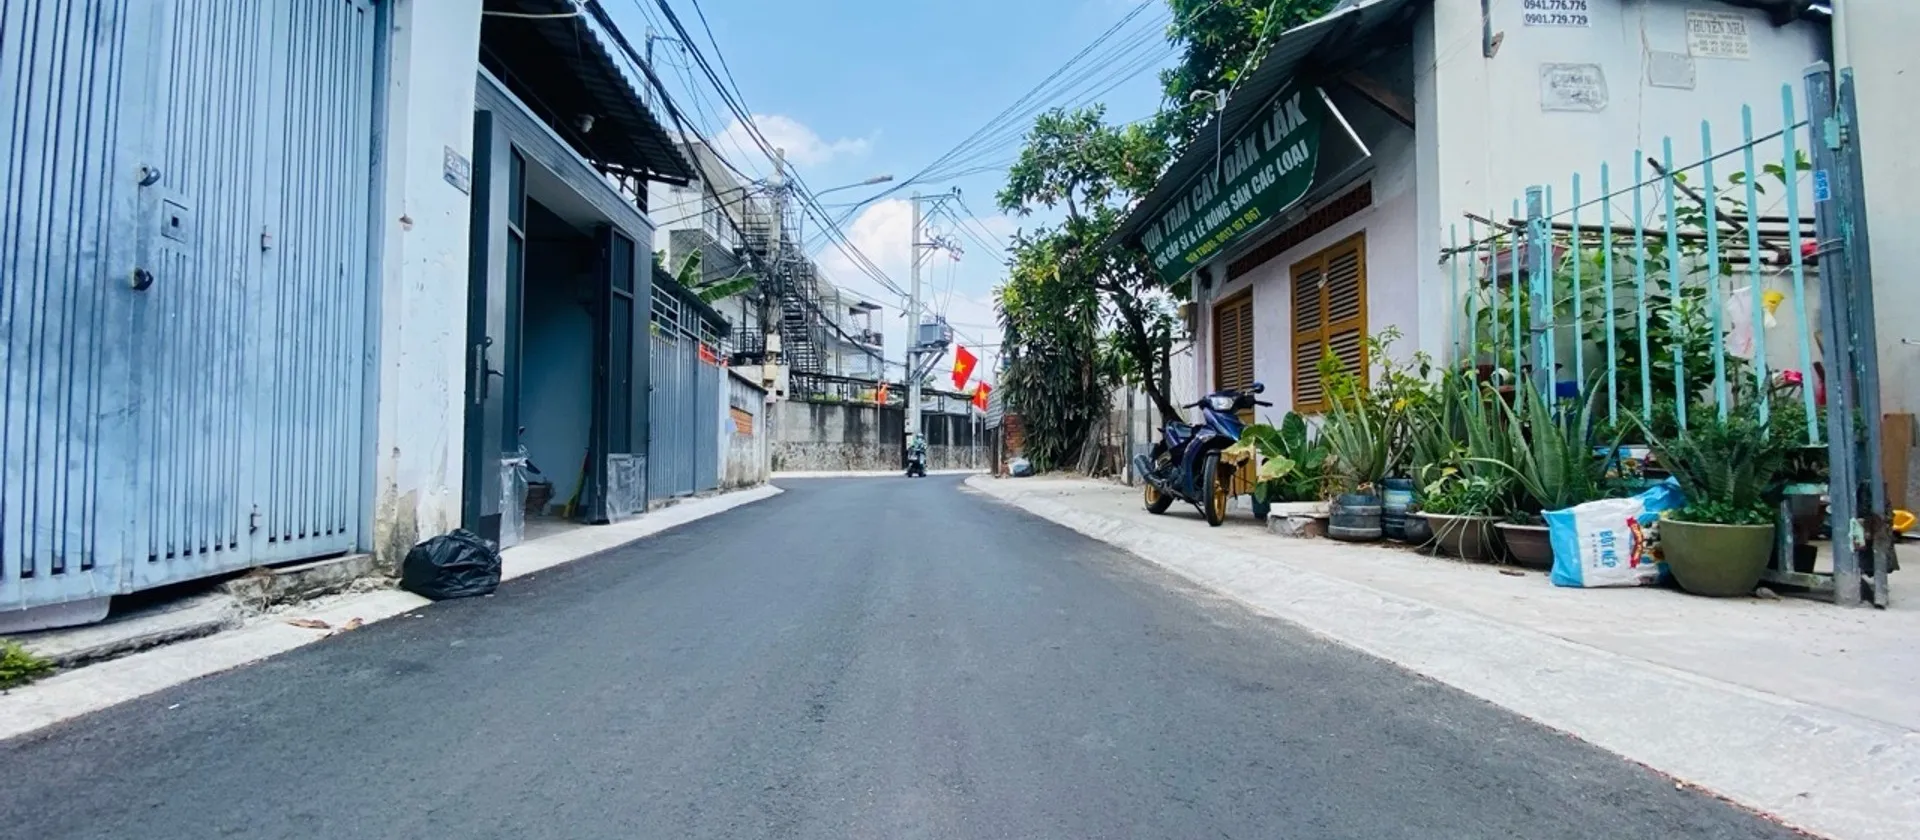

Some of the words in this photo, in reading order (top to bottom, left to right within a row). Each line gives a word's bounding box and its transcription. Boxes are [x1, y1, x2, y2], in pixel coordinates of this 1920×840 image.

[1524, 0, 1587, 10] 0941.776.776
[1525, 13, 1588, 24] 0901.729.729
[1251, 164, 1276, 195] CÁC
[1276, 139, 1310, 177] LOẠI
[1599, 531, 1617, 547] BỘT
[1601, 550, 1620, 568] NẾP
